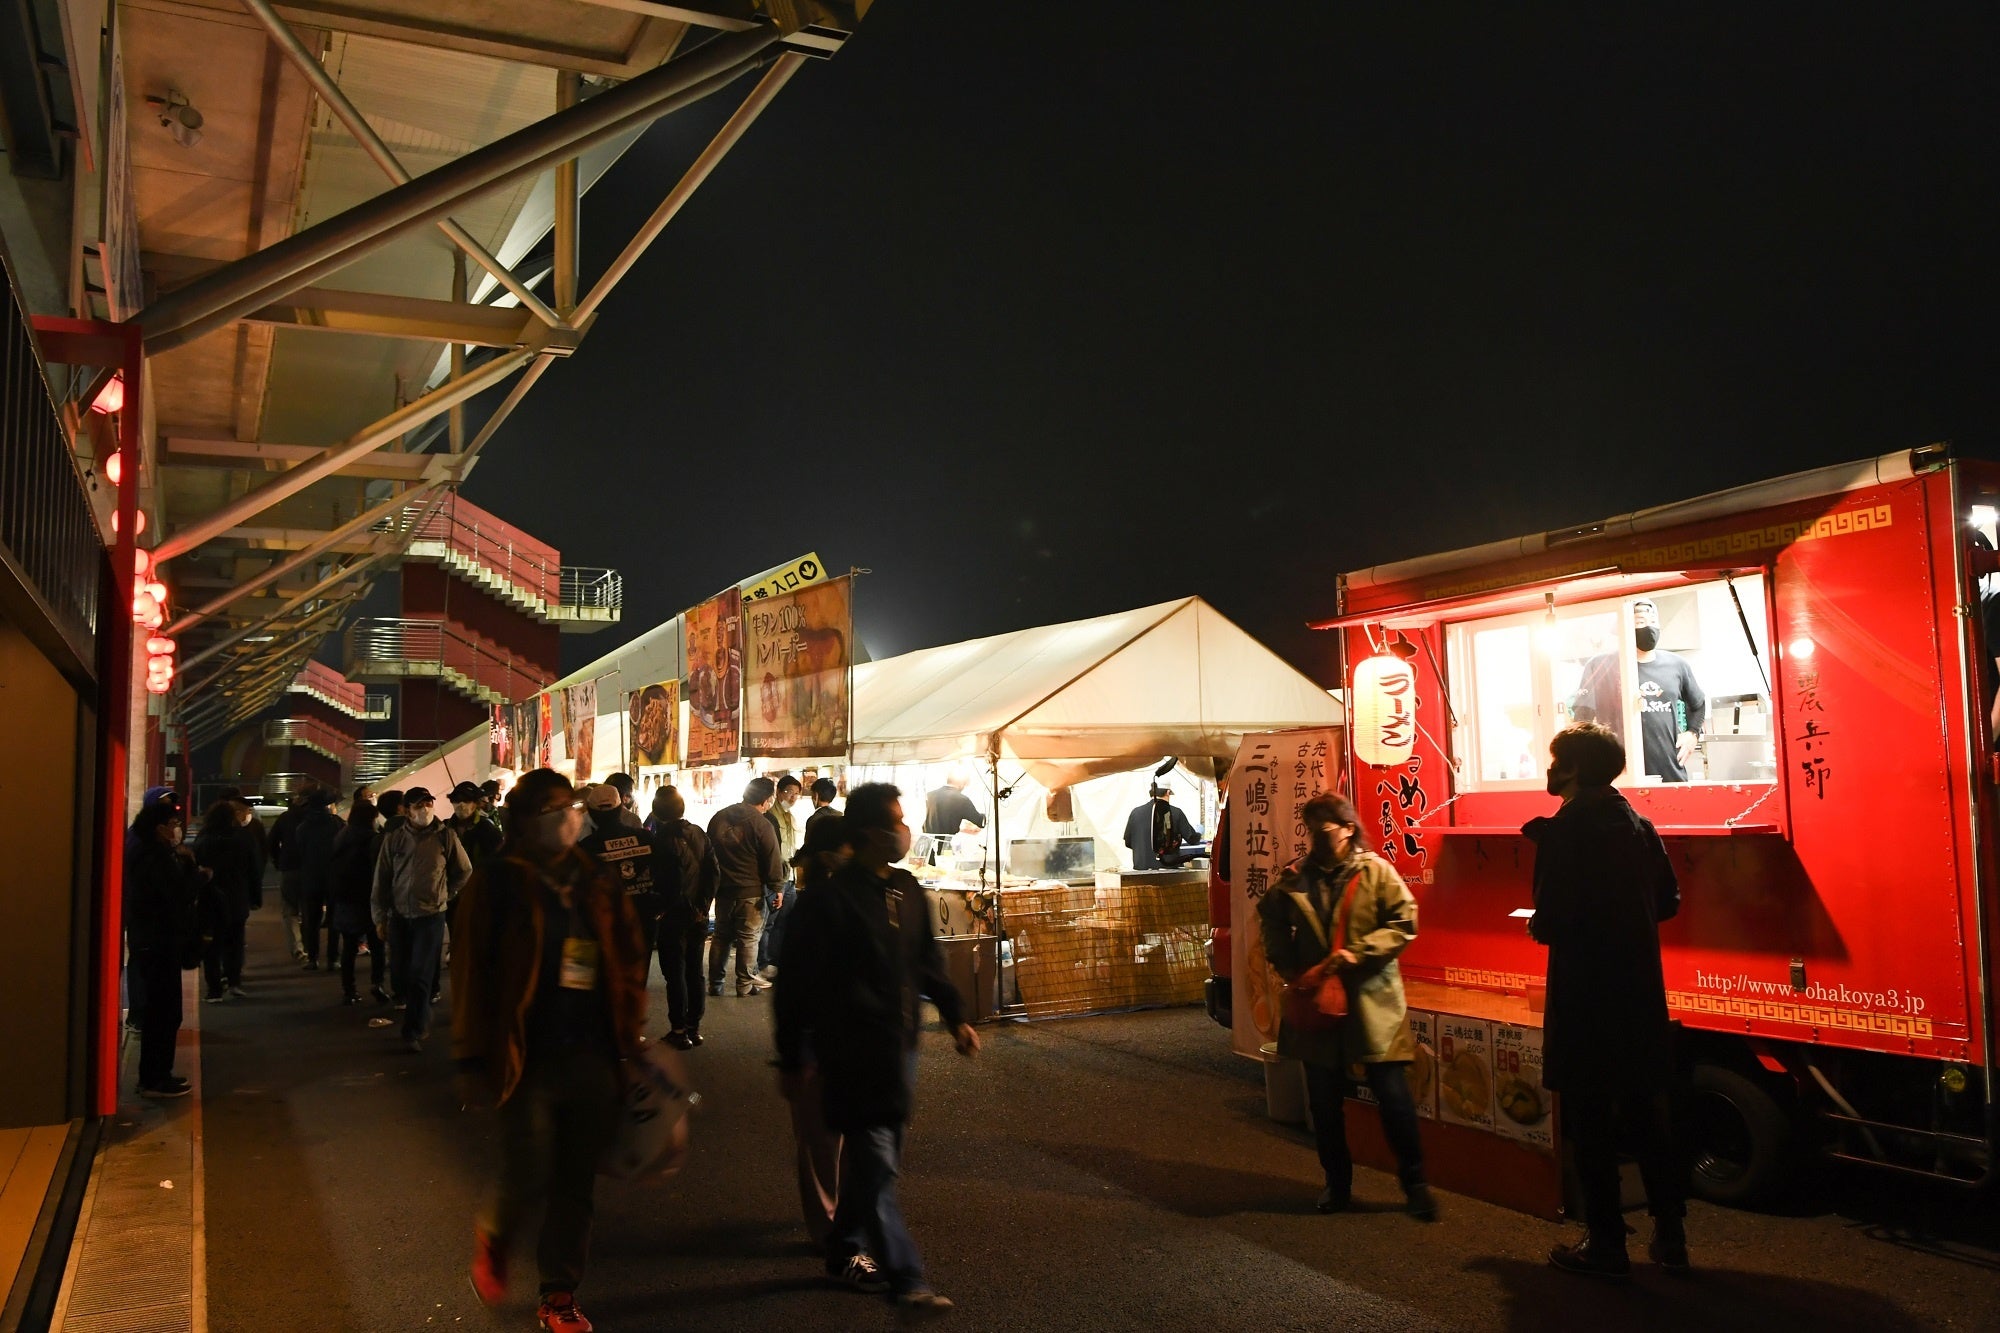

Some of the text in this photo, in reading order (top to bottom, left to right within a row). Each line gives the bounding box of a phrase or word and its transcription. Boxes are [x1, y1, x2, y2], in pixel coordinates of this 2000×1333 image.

[772, 571, 800, 594] 入口
[1379, 673, 1411, 748] ラーメン
[1796, 671, 1831, 800] 農兵節
[1270, 756, 1279, 795] みしま
[1245, 744, 1271, 899] 三嶋拉麺
[1270, 836, 1281, 883] らーめ
